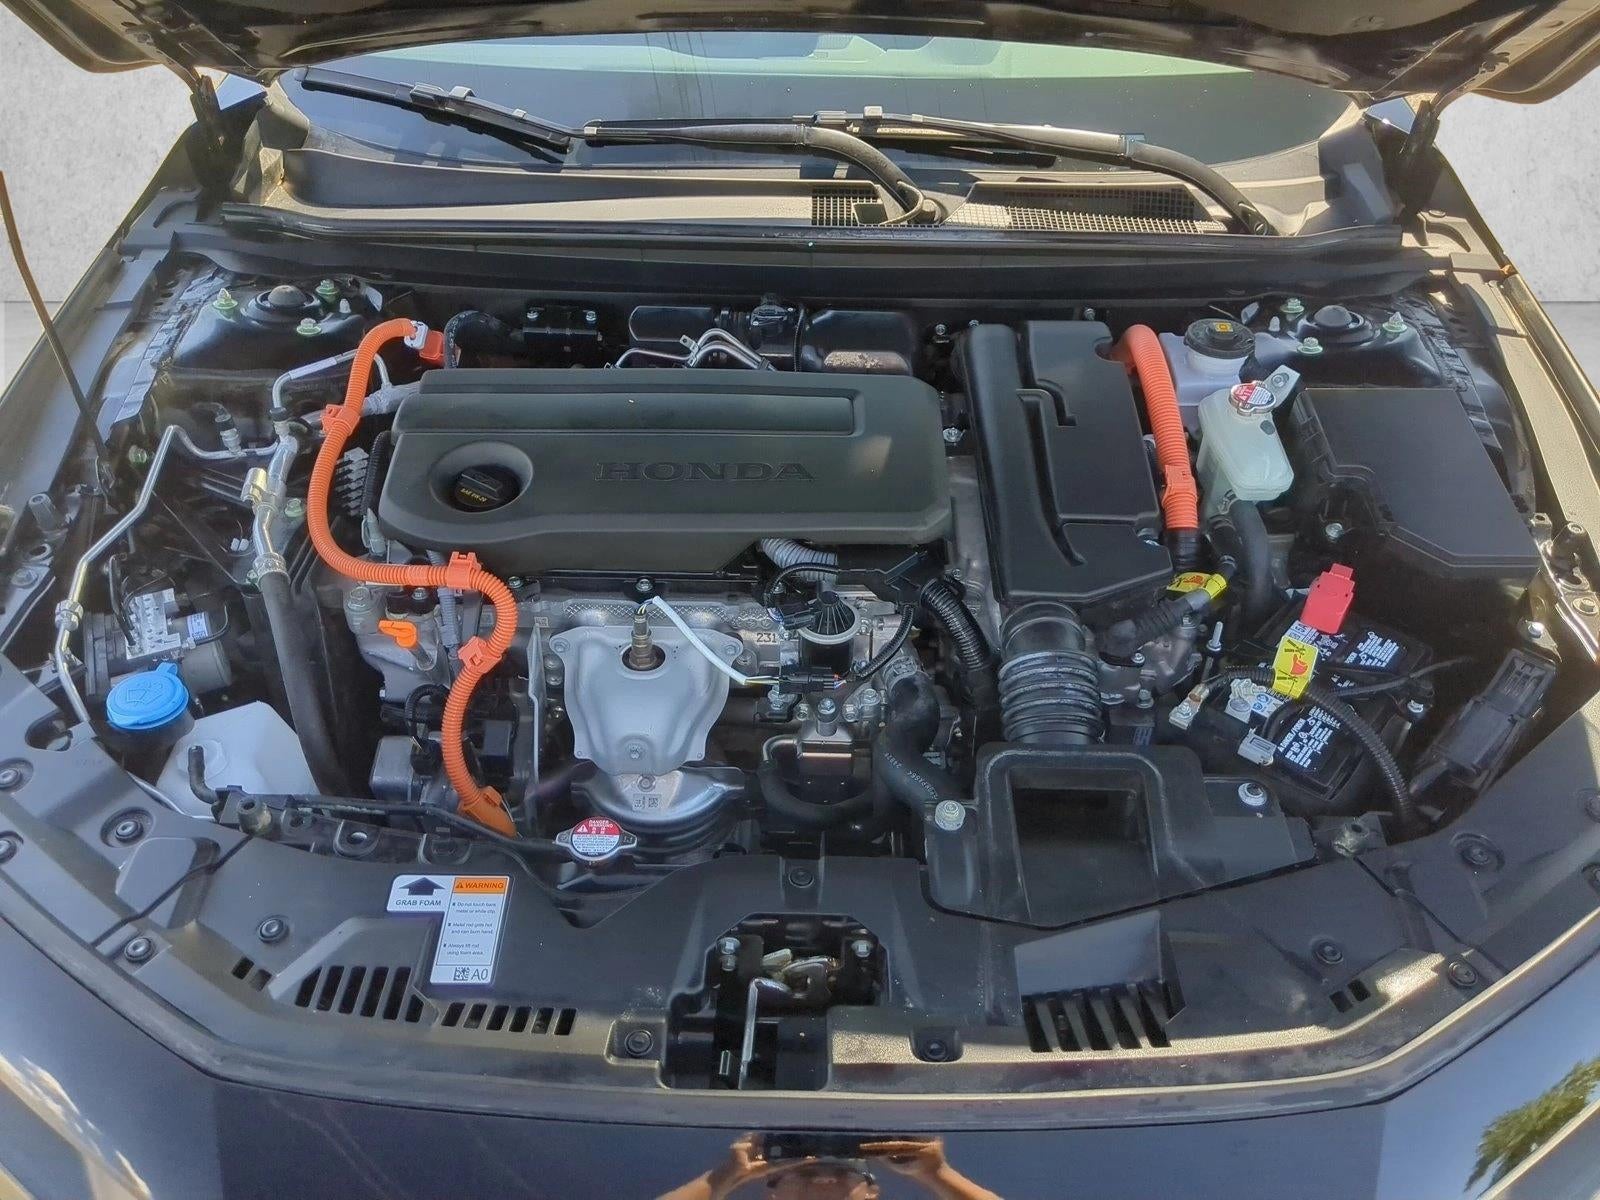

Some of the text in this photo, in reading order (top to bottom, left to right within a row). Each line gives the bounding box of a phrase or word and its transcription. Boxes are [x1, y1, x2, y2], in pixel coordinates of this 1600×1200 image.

[594, 462, 818, 481] HONDA
[756, 632, 777, 643] 231
[471, 968, 489, 981] A0
